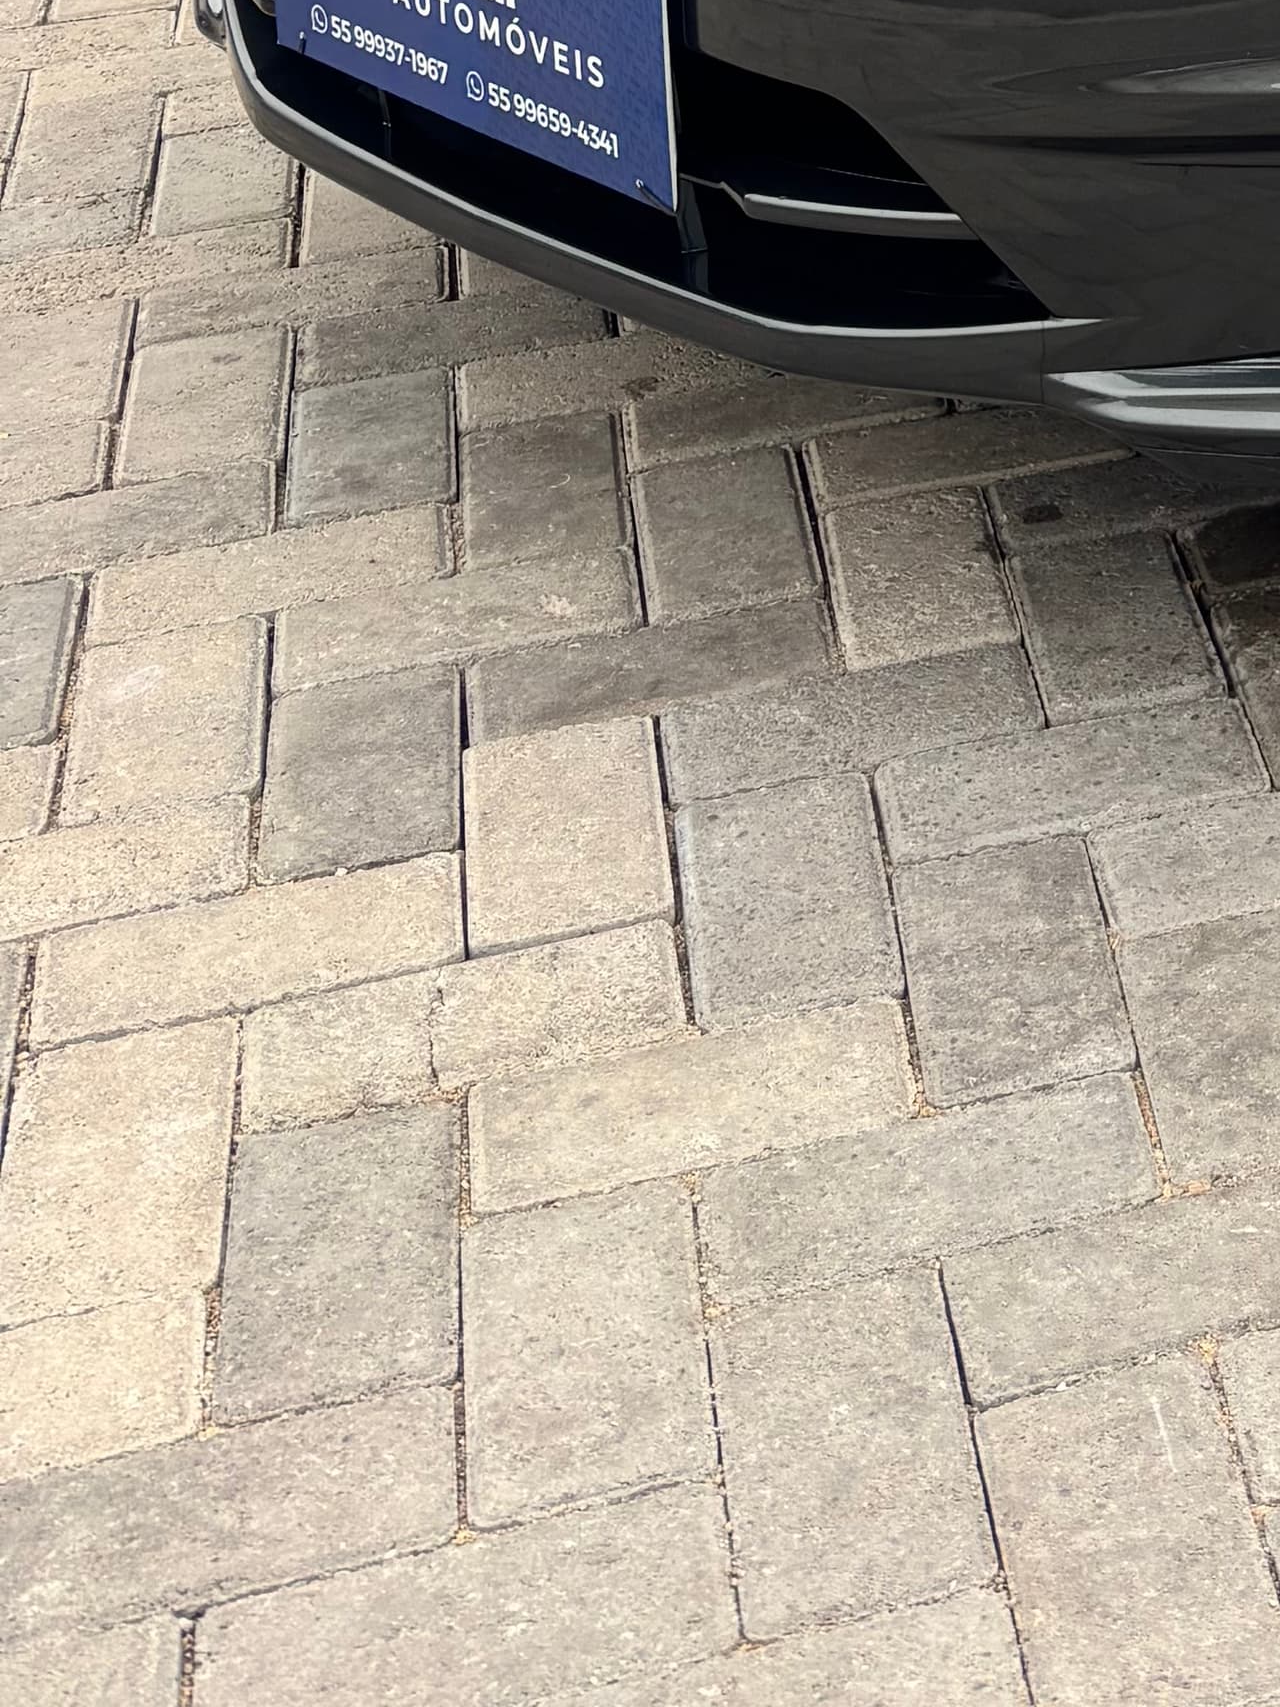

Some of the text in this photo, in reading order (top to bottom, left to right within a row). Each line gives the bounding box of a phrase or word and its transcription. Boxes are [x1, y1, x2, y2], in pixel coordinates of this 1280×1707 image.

[331, 15, 448, 84] 55 99937-1967
[488, 82, 619, 159] 55 99659-4341
